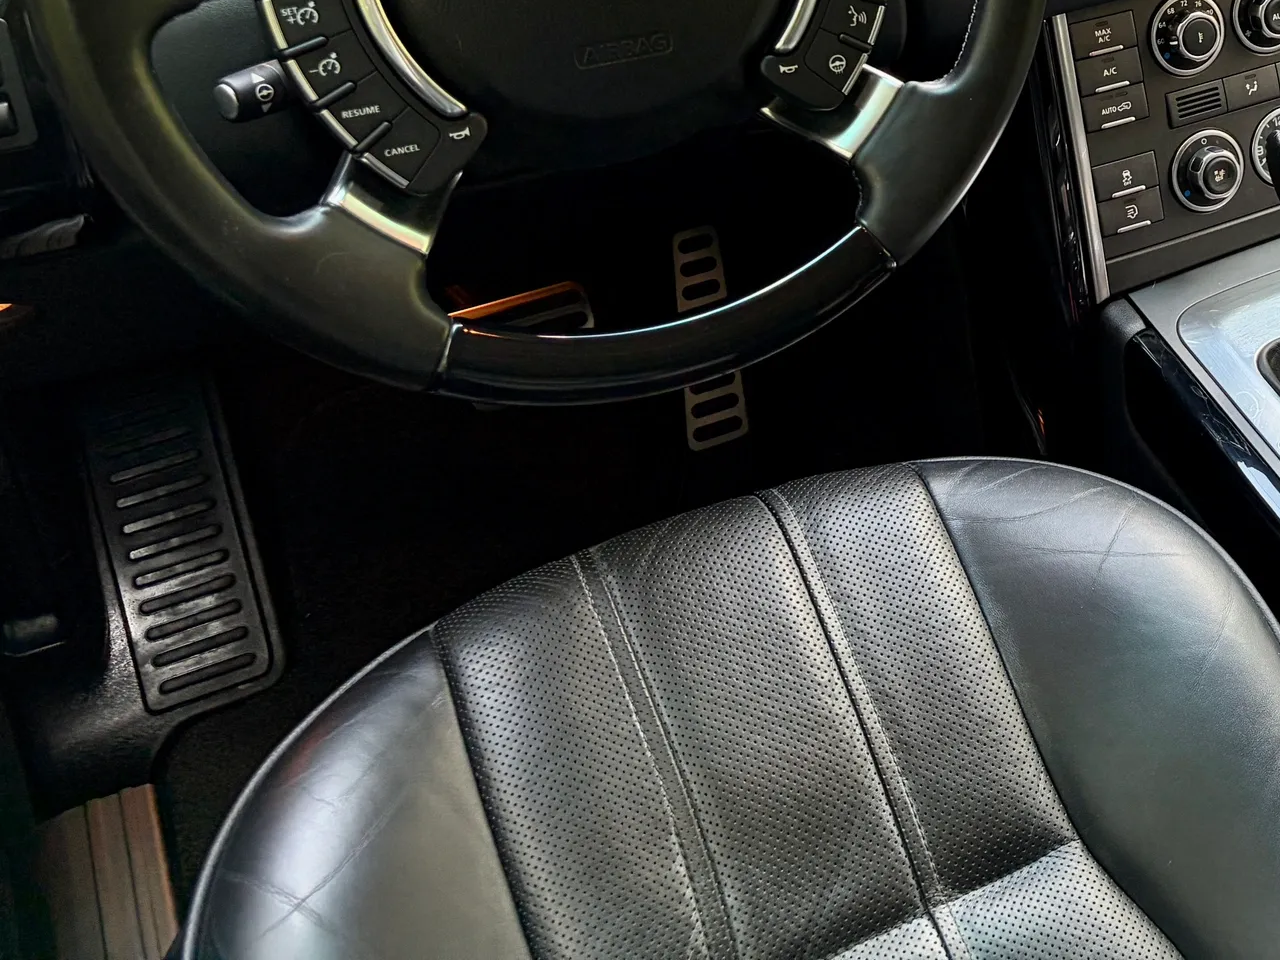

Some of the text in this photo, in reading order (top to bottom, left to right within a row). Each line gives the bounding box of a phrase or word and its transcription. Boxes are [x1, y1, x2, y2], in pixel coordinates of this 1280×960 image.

[281, 6, 298, 18] SET
[1094, 27, 1112, 37] MAX
[1098, 35, 1111, 44] A/C
[1103, 66, 1118, 77] A/C
[341, 104, 381, 120] RESUME
[1101, 105, 1117, 116] AUTO
[383, 143, 421, 157] CANCEL
